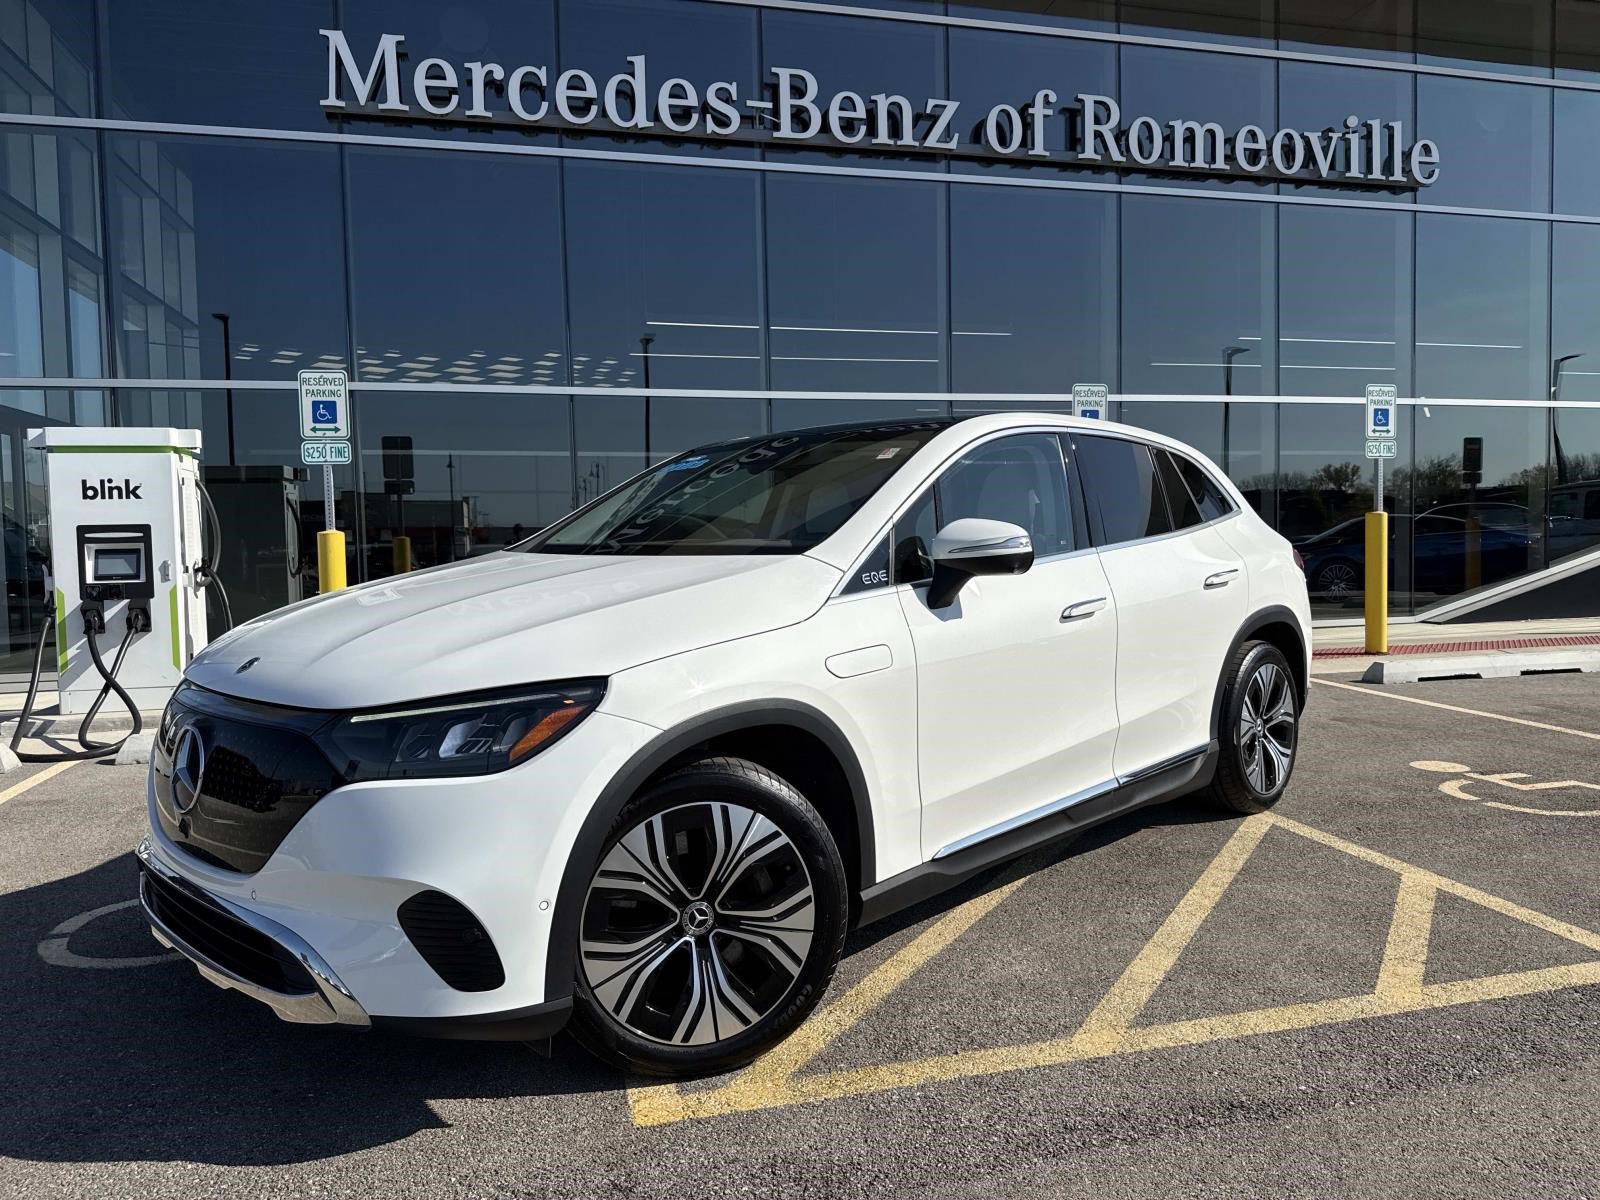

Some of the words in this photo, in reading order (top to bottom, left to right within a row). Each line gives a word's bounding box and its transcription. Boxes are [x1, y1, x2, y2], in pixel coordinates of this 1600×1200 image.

[319, 28, 960, 150] Mercedes-Benz
[986, 89, 1057, 158] of
[1076, 93, 1441, 185] Romeoville
[302, 377, 344, 386] RESERVED
[305, 389, 342, 398] PARKING
[1077, 400, 1104, 408] PARKING
[305, 446, 327, 459] $250
[330, 446, 348, 459] FINE
[1368, 445, 1382, 454] $250
[1383, 445, 1394, 454] FINE
[81, 478, 144, 501] blink
[862, 569, 888, 584] EQE
